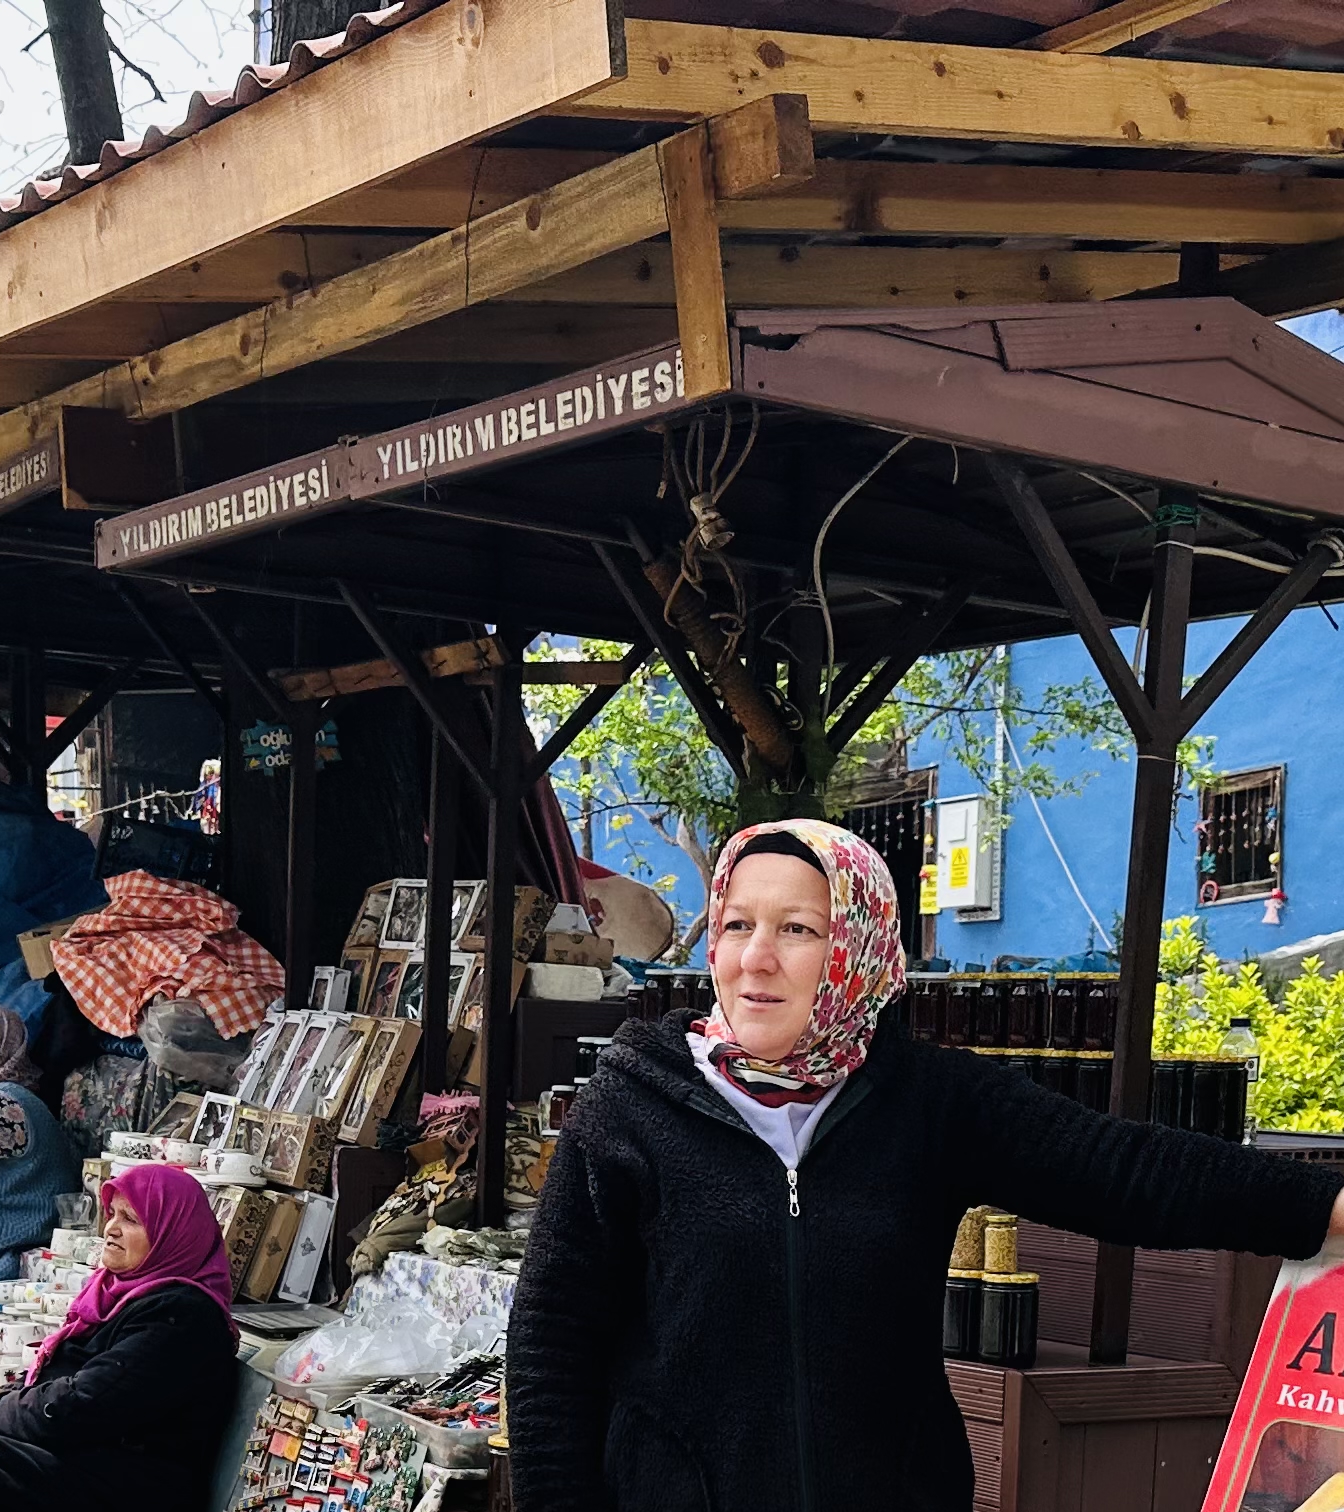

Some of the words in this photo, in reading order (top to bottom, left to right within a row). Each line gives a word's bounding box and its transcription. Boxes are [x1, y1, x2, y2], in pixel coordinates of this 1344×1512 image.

[377, 414, 495, 480] YILDIRIM
[119, 505, 202, 557] YILDIRIM
[206, 459, 329, 532] BELEDİYESİ
